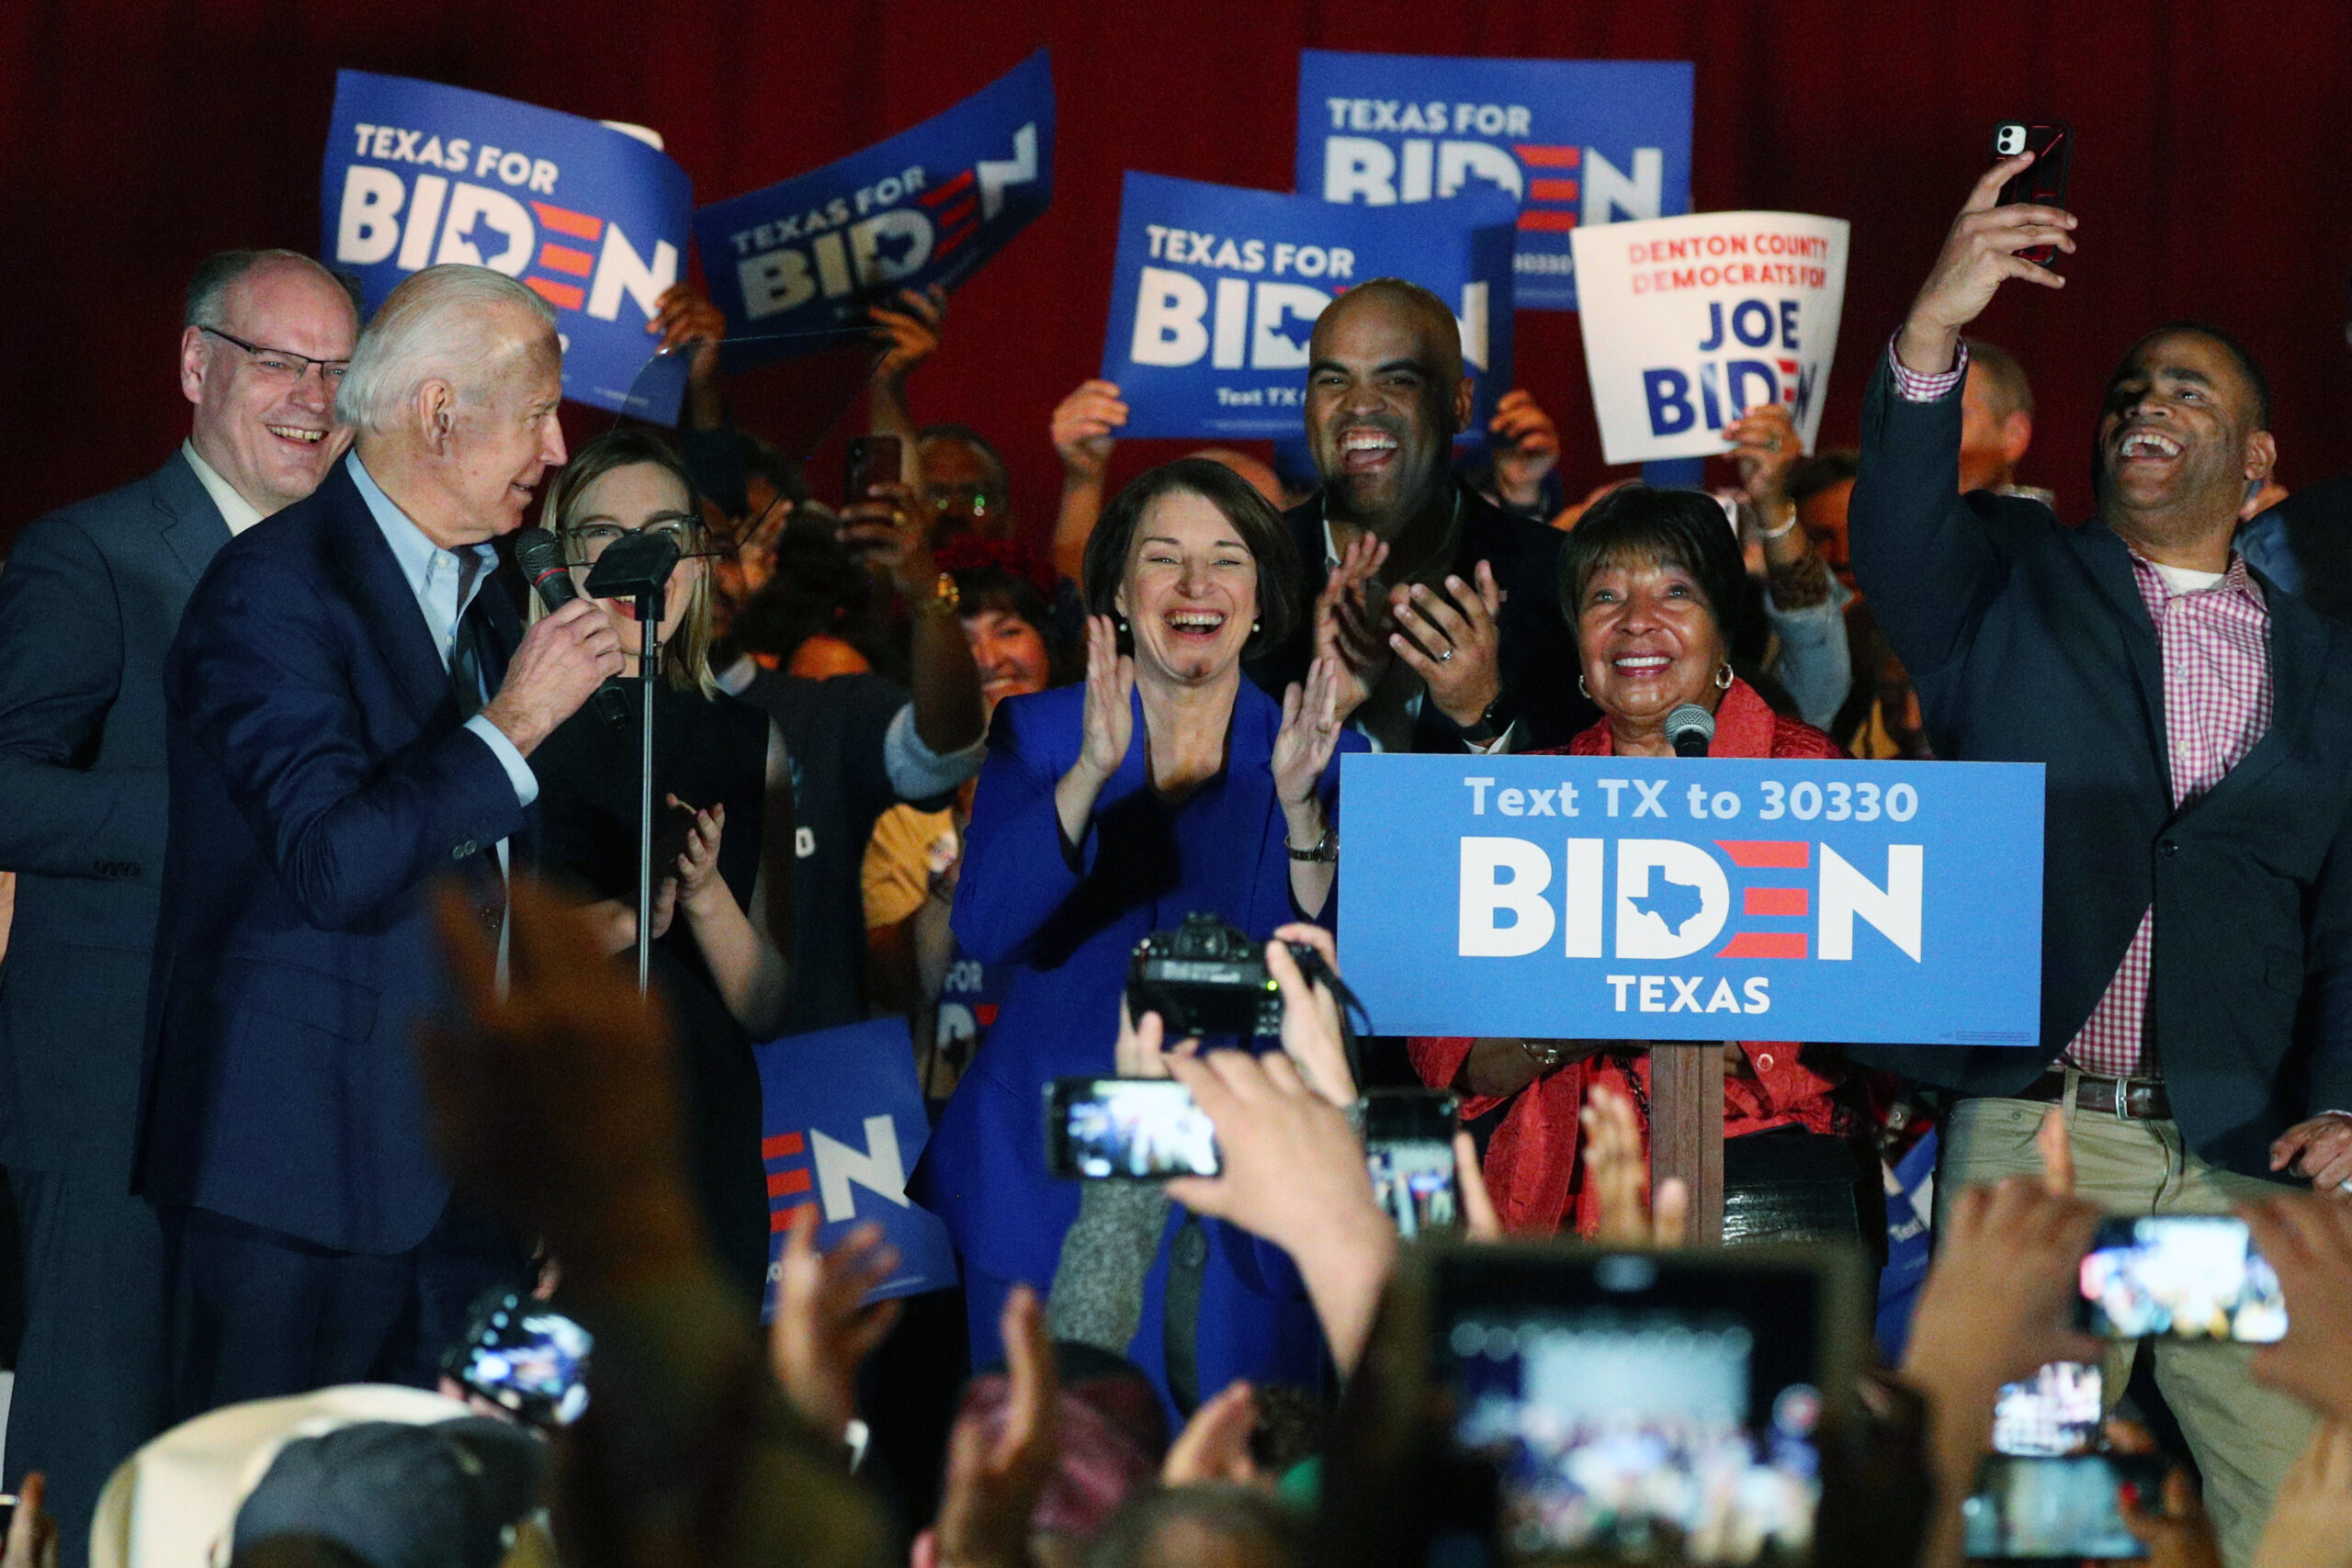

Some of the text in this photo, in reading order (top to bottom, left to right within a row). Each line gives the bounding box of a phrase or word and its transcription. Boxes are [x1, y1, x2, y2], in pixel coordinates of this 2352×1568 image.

[1326, 96, 1532, 137] TEXAS FOR
[354, 123, 560, 195] TEXAS FOR
[733, 164, 927, 254] TEXAS FOR
[737, 119, 1039, 321] BIDEN
[336, 164, 679, 322] BIDEN
[1146, 223, 1355, 278] TEXAS FOR
[1628, 232, 1829, 265] DENTON COUNTY
[1631, 262, 1794, 296] DEMOCRATS
[1699, 298, 1801, 353] JOE
[1464, 776, 1919, 823] Text TX to 30330
[1458, 835, 1924, 964] BIDEN
[1606, 974, 1771, 1016] TEXAS
